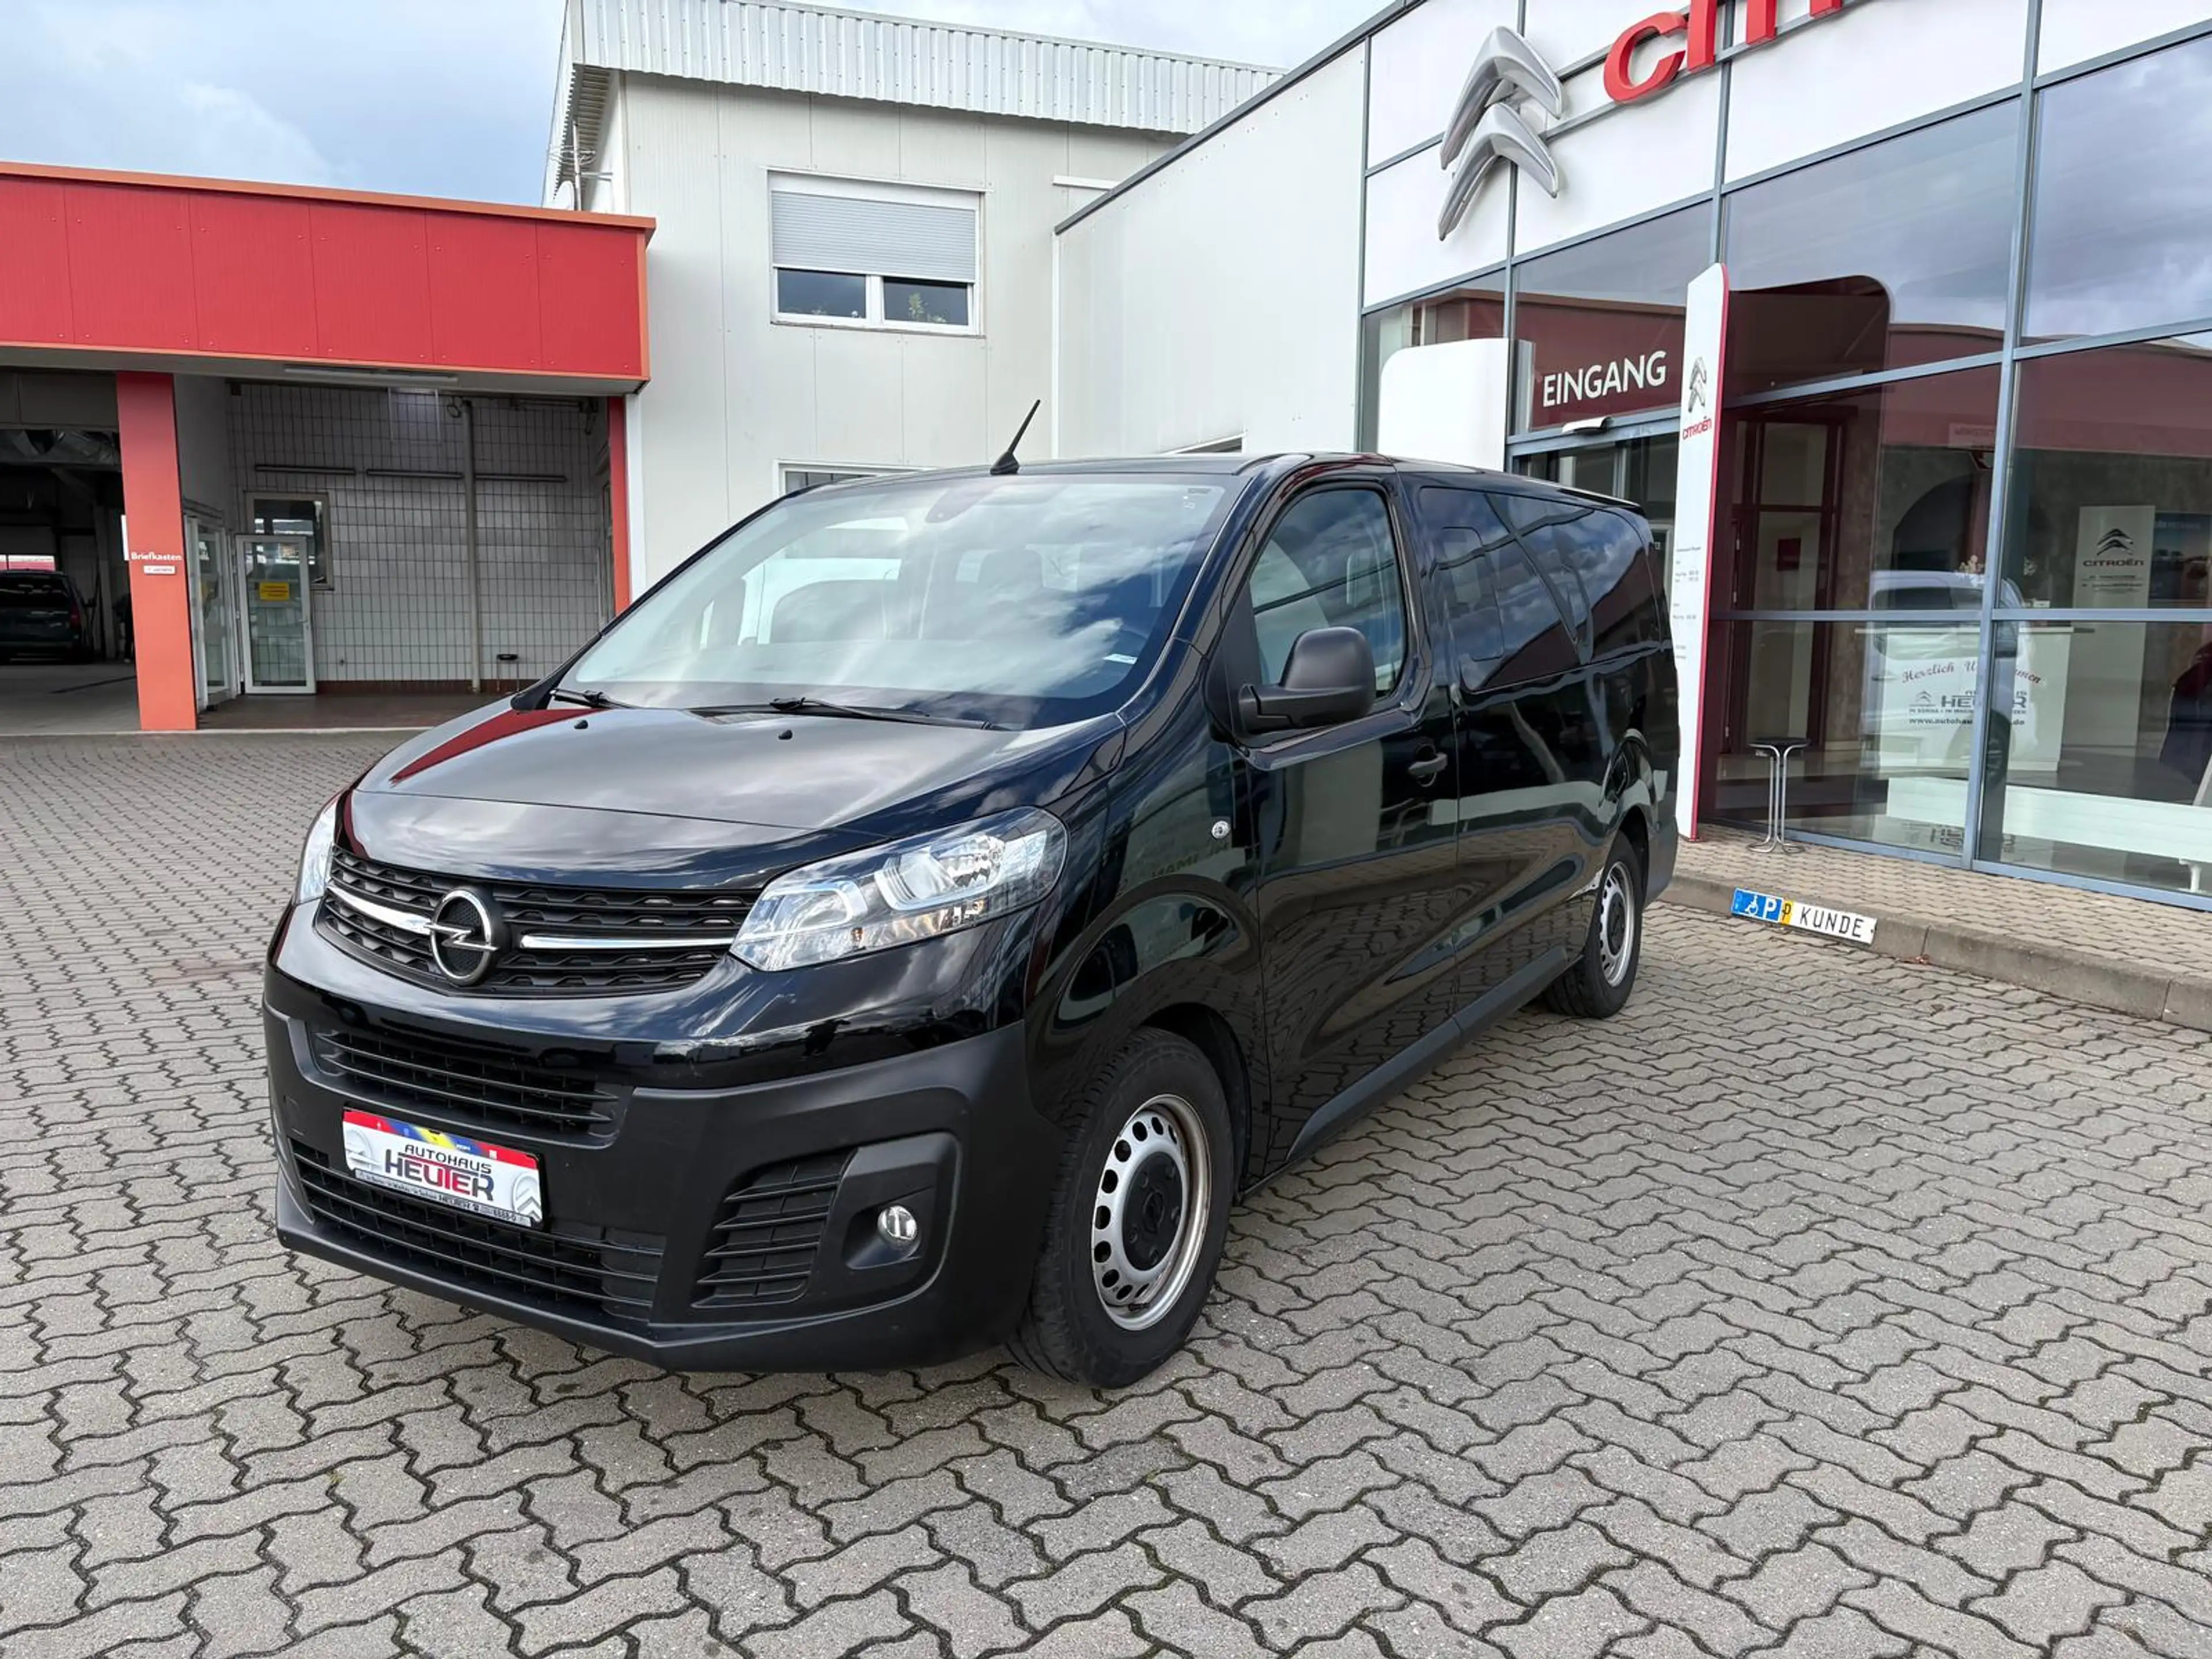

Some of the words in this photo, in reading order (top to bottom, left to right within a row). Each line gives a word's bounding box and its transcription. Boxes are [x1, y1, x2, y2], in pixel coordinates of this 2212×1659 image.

[1543, 350, 1666, 407] EINGANG
[130, 551, 183, 561] Briefkasten
[1763, 898, 1777, 919] P
[1800, 907, 1864, 938] KUNDE
[385, 1149, 494, 1201] HEUTER
[404, 1144, 493, 1175] AUTOHAUS
